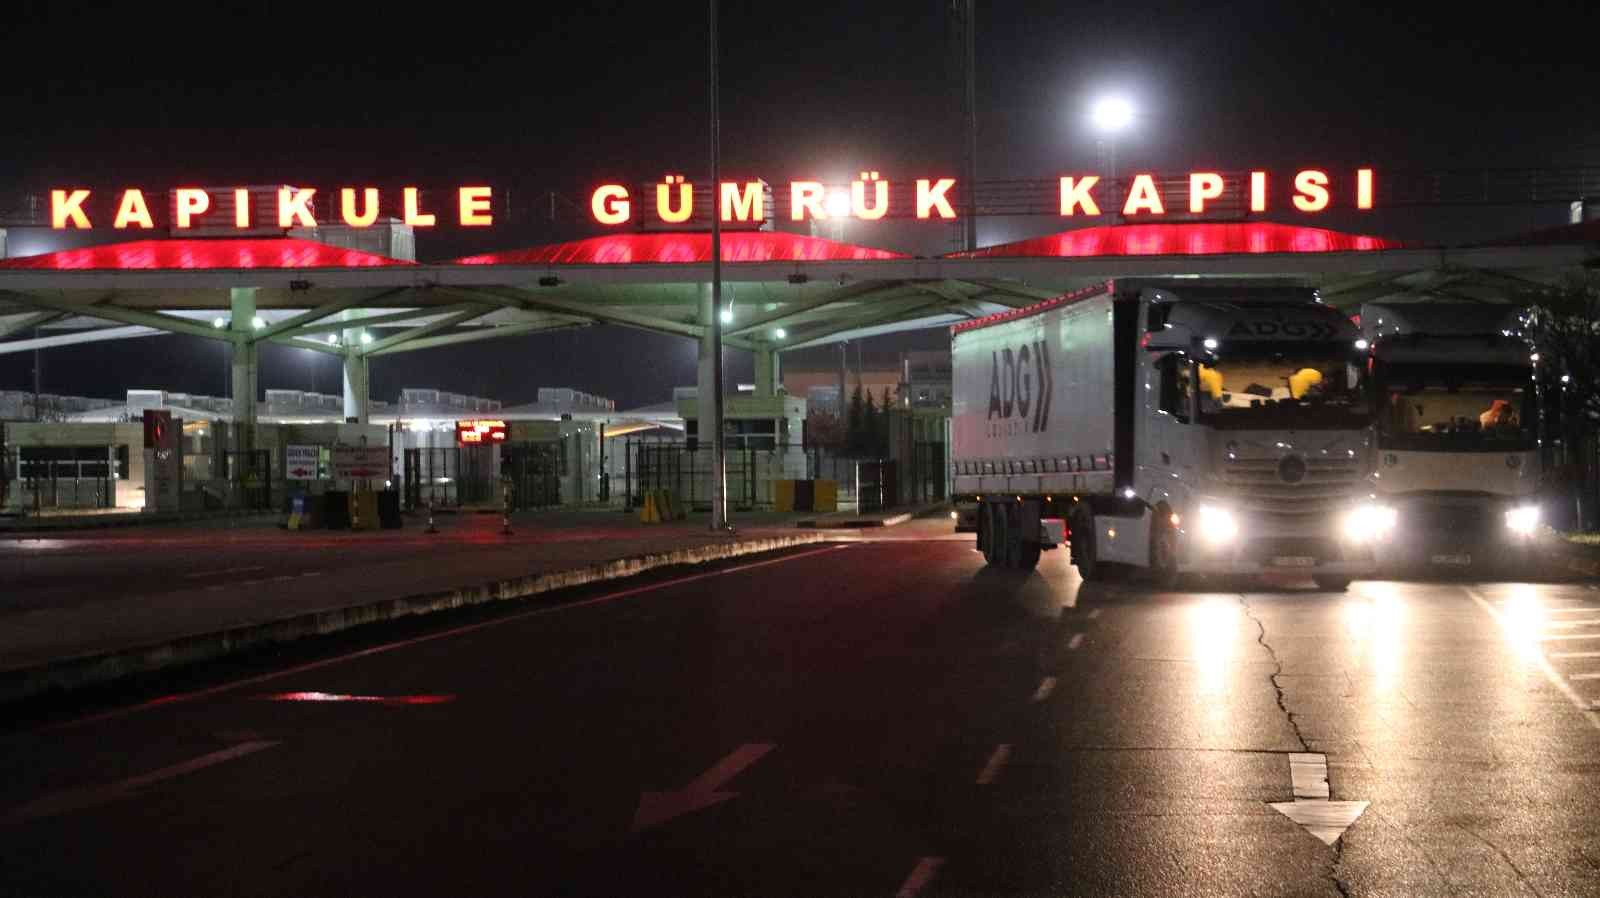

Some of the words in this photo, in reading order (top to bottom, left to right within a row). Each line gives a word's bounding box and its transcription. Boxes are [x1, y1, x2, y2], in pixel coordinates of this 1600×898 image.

[51, 186, 494, 228] KAPIKULE
[590, 171, 957, 225] GÜMRÜK
[1059, 168, 1376, 217] KAPISI
[1230, 320, 1307, 338] ADG
[988, 343, 1031, 420] ADG
